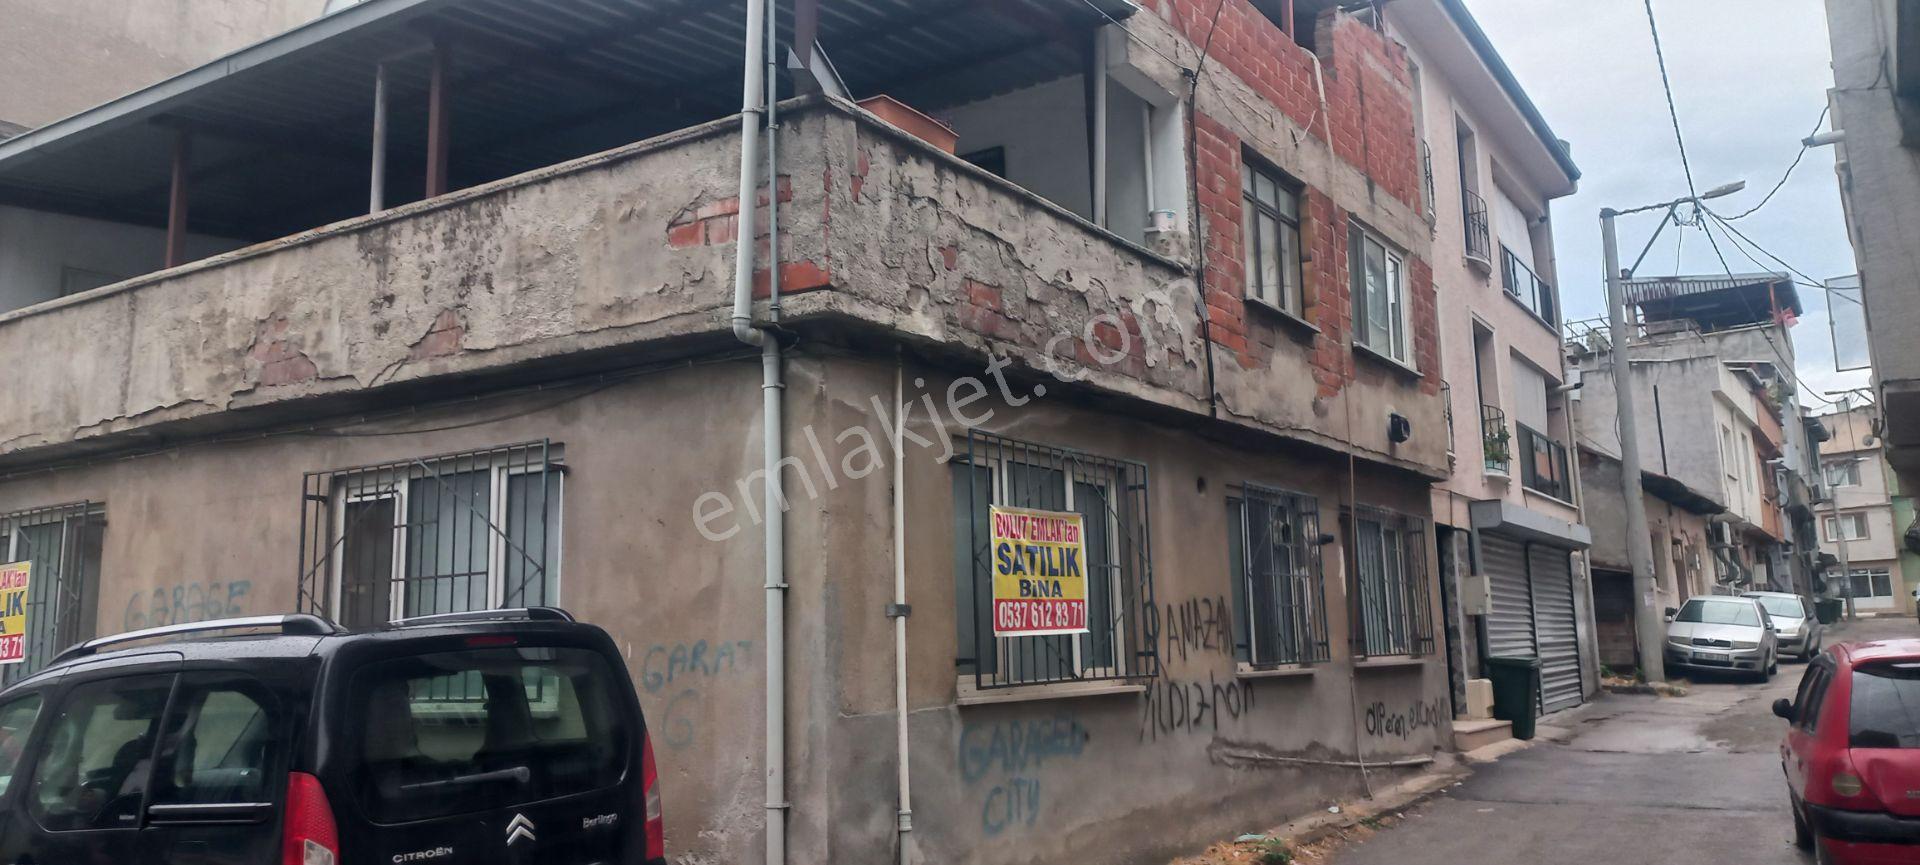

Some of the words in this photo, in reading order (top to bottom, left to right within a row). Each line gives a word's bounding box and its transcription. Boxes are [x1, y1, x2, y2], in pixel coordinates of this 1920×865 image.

[995, 512, 1029, 540] BULUT
[997, 542, 1081, 577] SATILIK
[999, 601, 1028, 629] 0537
[1030, 601, 1052, 628] 612
[1055, 601, 1069, 627] 83
[1071, 601, 1084, 626] 71
[11, 636, 24, 657] 71
[392, 846, 453, 863] CITROËN
